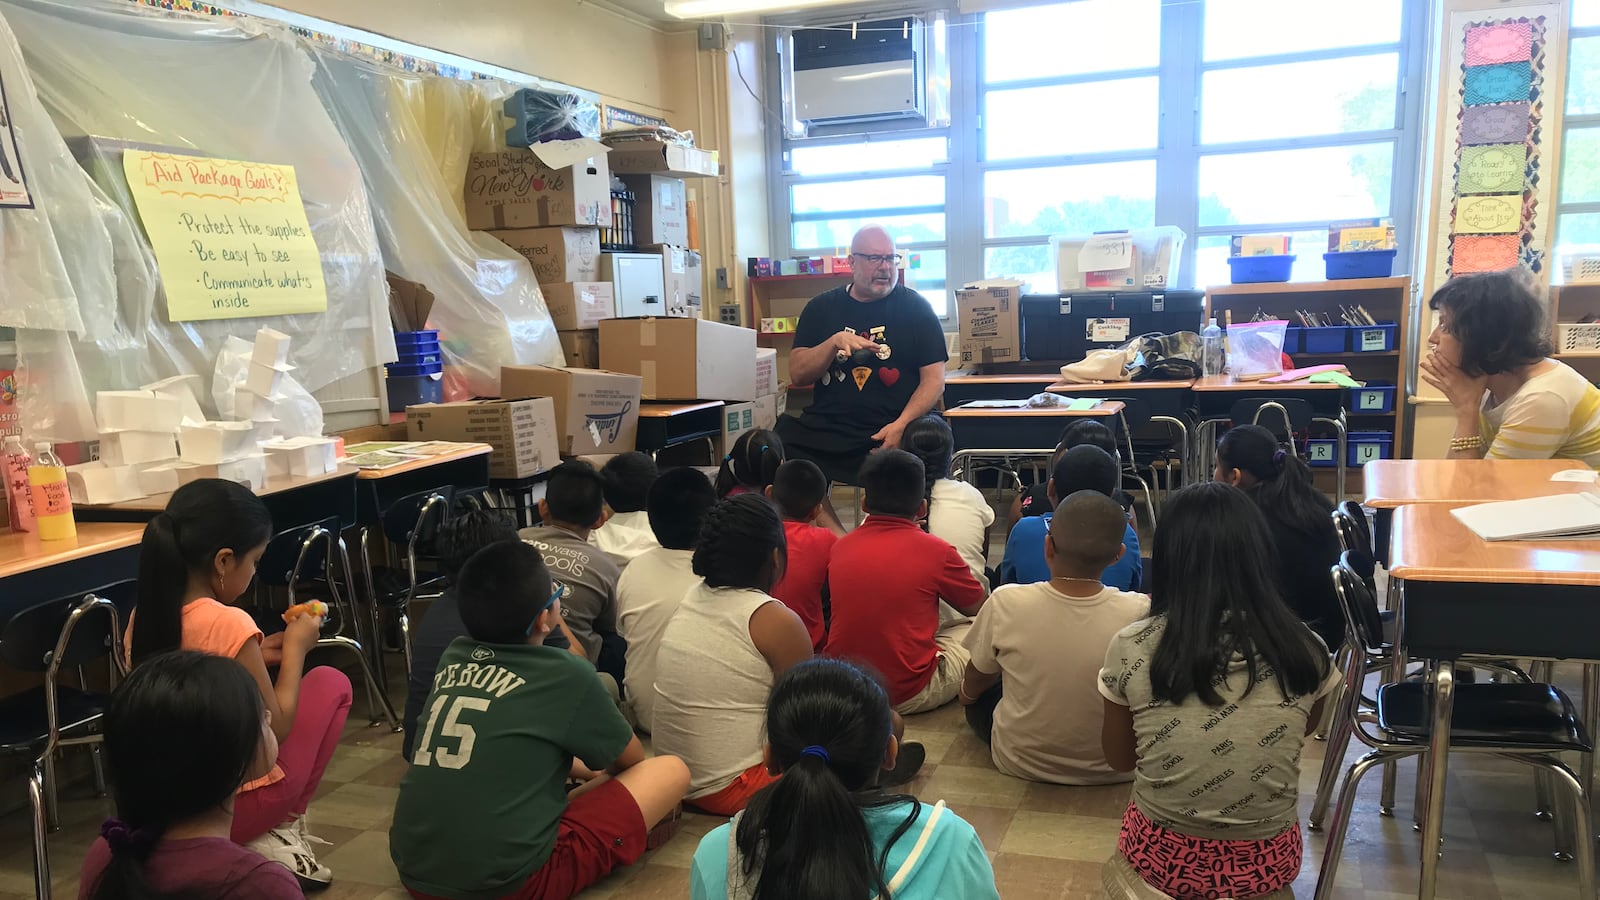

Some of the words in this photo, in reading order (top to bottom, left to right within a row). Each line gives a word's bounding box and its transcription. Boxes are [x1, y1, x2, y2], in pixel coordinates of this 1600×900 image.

[472, 153, 500, 169] Social
[502, 152, 535, 167] Studies
[152, 161, 183, 184] Aid
[185, 161, 241, 197] Package
[470, 173, 511, 196] New
[180, 211, 235, 235] Protect
[240, 215, 263, 236] the
[265, 218, 306, 241] supplies
[191, 239, 217, 262] Be
[222, 248, 250, 266] easy
[253, 242, 267, 263] to
[271, 251, 291, 263] see
[203, 270, 275, 290] Communicate
[276, 269, 312, 289] what's
[1158, 274, 1164, 283] 3
[212, 294, 250, 309] inside
[1368, 394, 1377, 405] P
[1317, 446, 1325, 457] R
[1364, 447, 1373, 458] U
[432, 662, 527, 698] TEBOW
[1220, 703, 1240, 720] NEW
[413, 694, 492, 770] 15
[1154, 716, 1182, 742] ANGELES
[1199, 715, 1223, 732] YORK
[1257, 723, 1289, 748] LONDON
[1210, 737, 1234, 756] PARIS
[1161, 754, 1185, 772] TOKYO
[1250, 763, 1275, 783] TOKYO
[1188, 788, 1204, 798] LOS
[1202, 768, 1236, 792] ANGELES
[1218, 803, 1237, 817] NEW
